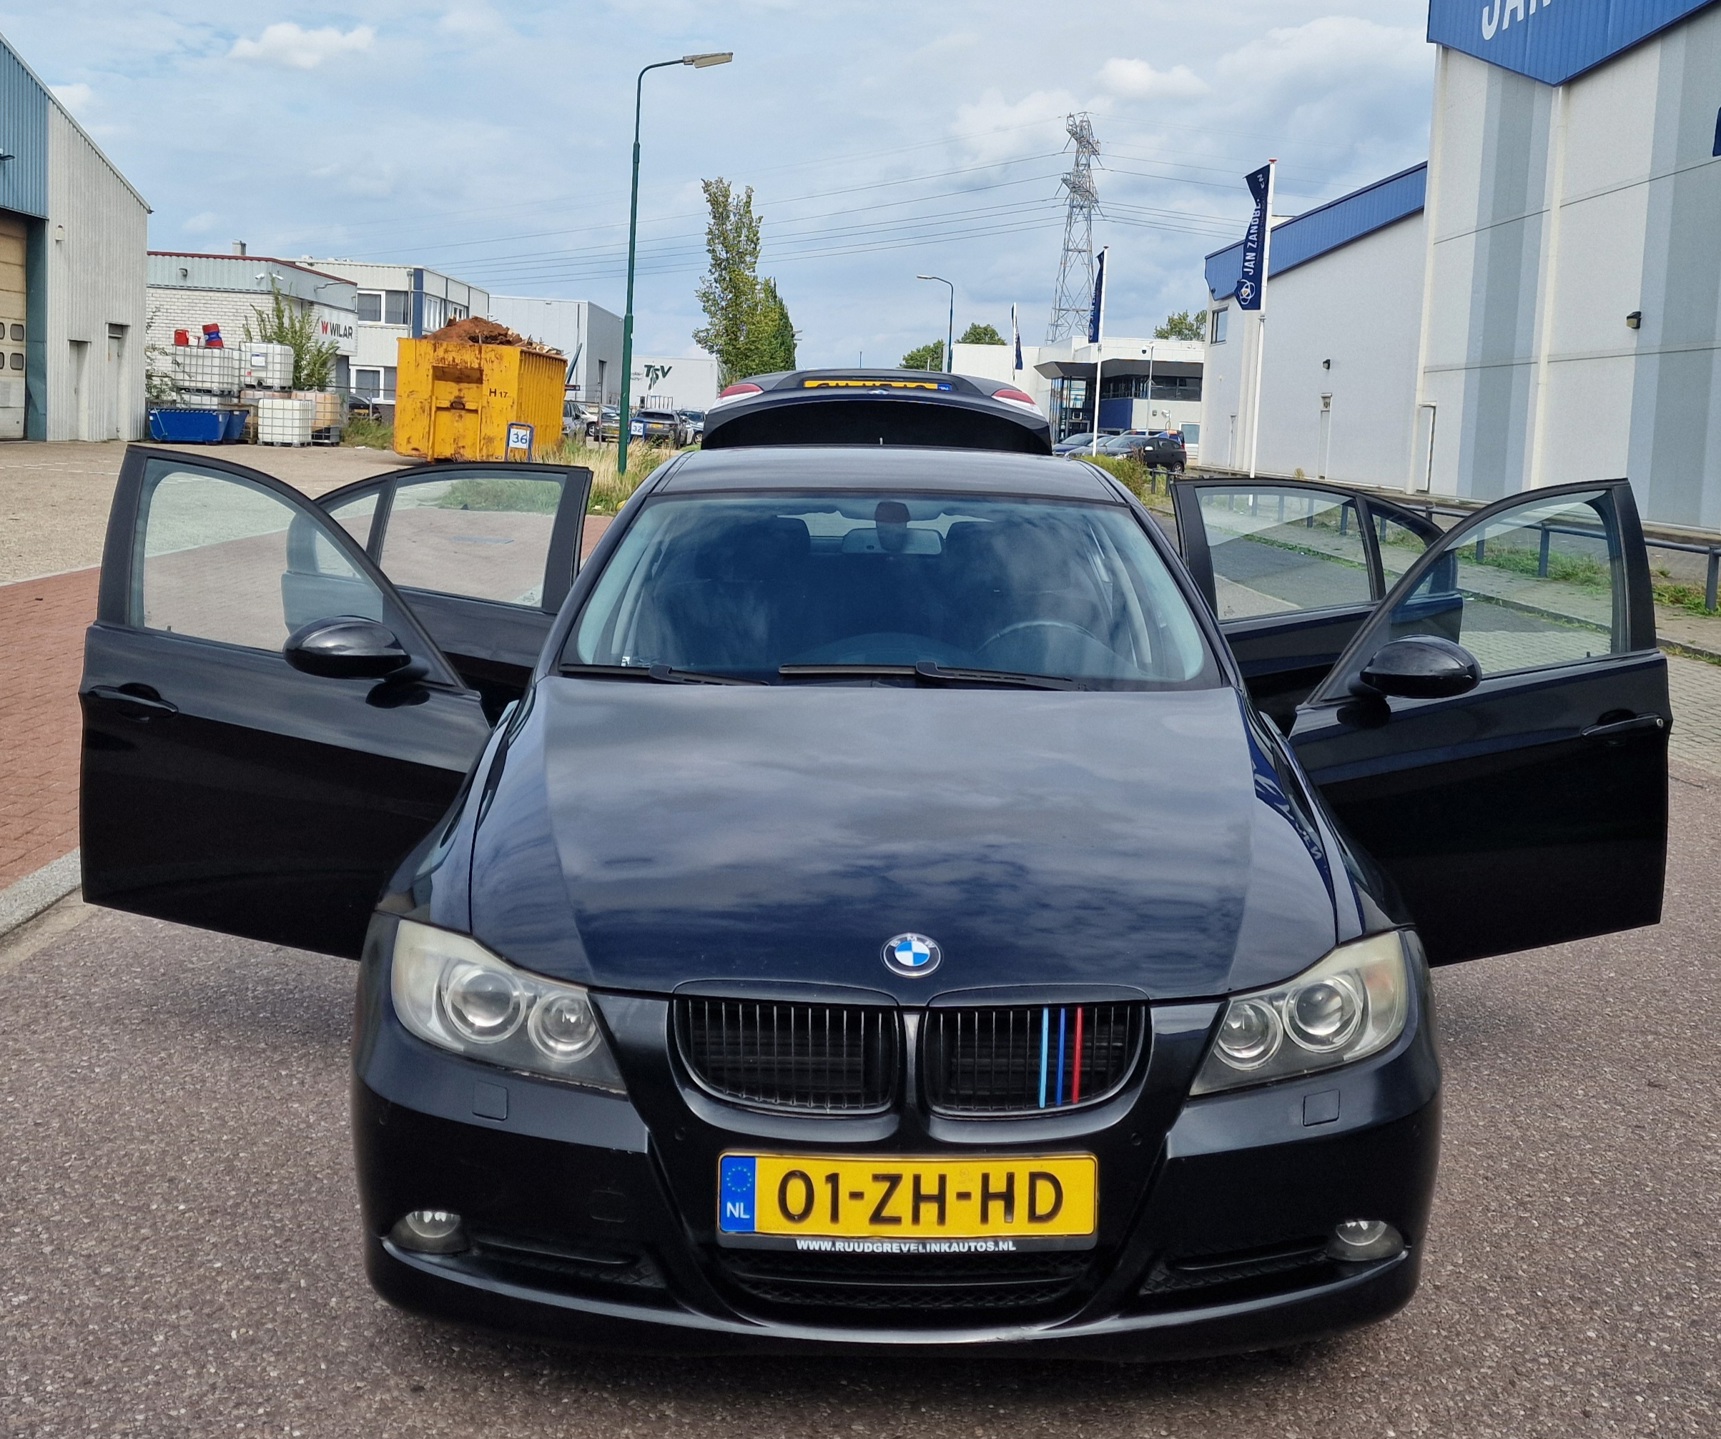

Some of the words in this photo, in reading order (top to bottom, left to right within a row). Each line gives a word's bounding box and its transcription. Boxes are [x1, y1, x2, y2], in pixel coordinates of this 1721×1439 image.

[1243, 252, 1256, 275] JAN
[330, 322, 353, 339] WILAR
[644, 364, 673, 386] TSV
[489, 388, 497, 397] H
[632, 425, 643, 433] 32
[512, 432, 528, 444] 36
[726, 1201, 750, 1219] NL
[777, 1169, 1064, 1226] 01-ZH-HD
[796, 1239, 1017, 1254] WWW.RUUDGREVELINKAUTOS.NL
